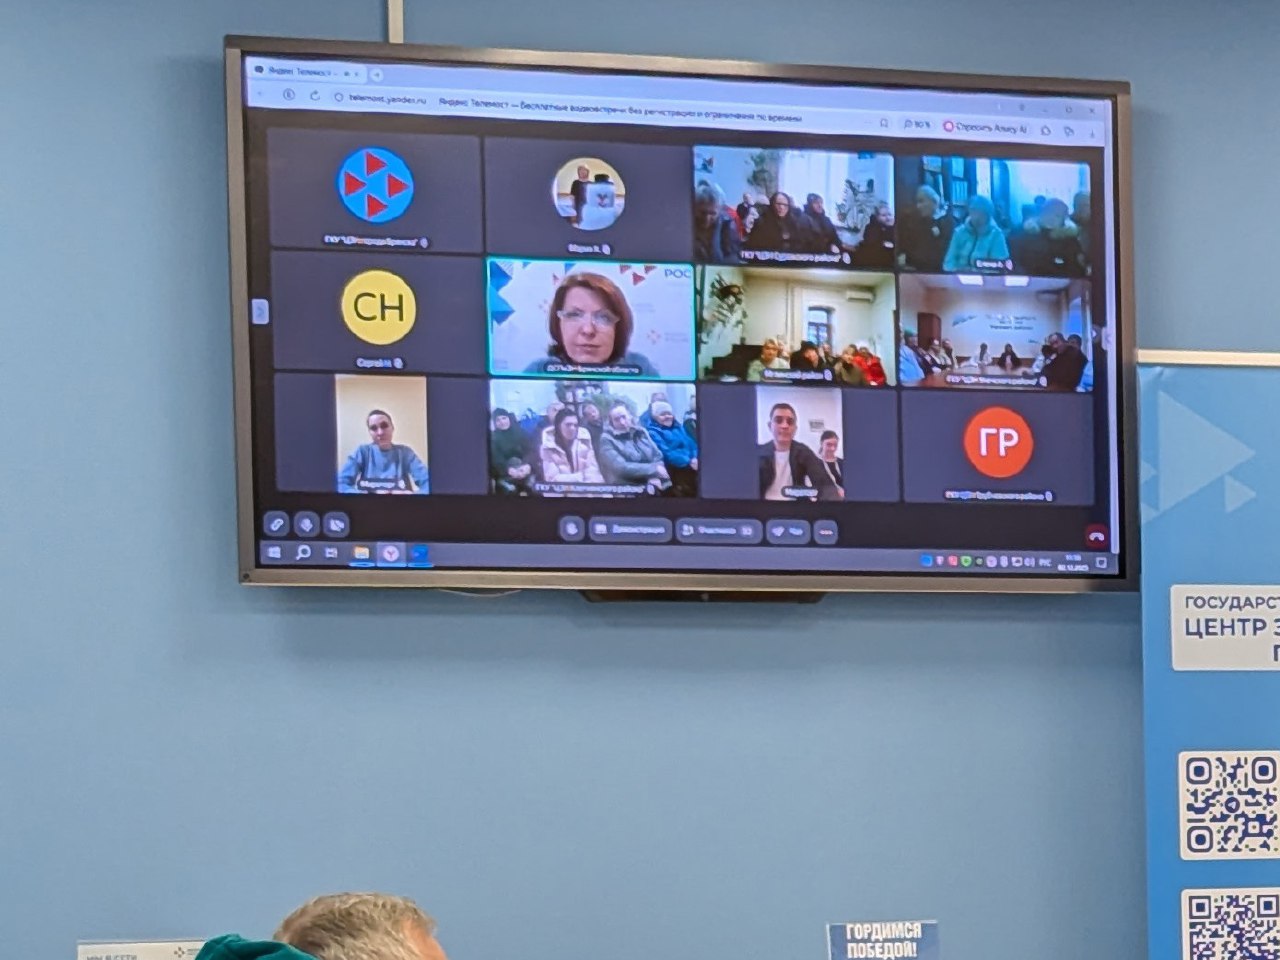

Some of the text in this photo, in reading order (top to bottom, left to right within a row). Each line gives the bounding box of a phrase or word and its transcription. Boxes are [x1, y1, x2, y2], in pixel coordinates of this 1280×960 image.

[980, 427, 1019, 457] ГР
[1185, 617, 1268, 639] ЦЕНТР
[846, 921, 922, 941] ГОРДИМСЯ
[847, 941, 918, 960] ПОБЕДОЙ!
